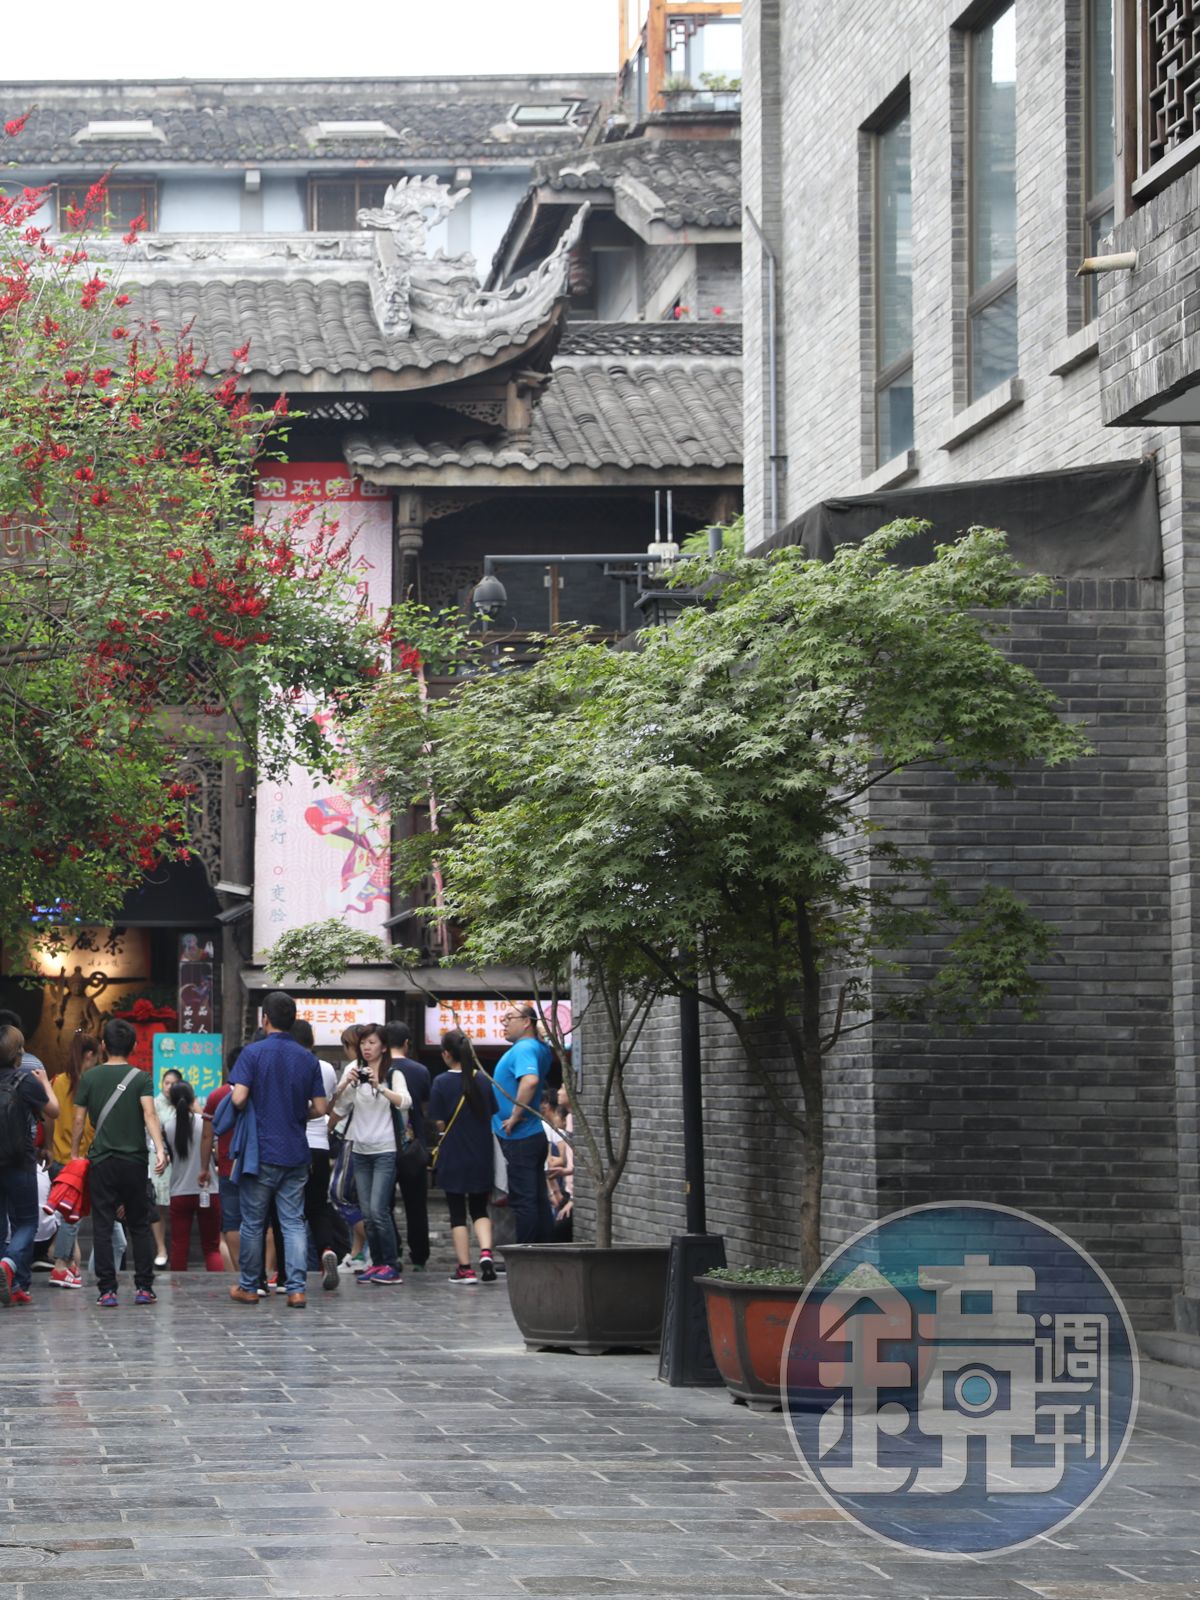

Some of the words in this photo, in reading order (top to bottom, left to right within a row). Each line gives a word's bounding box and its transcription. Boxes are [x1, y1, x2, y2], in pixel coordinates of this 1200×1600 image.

[268, 883, 288, 923] 变脸
[184, 1006, 193, 1033] 品茶
[440, 1027, 486, 1039] 大串
